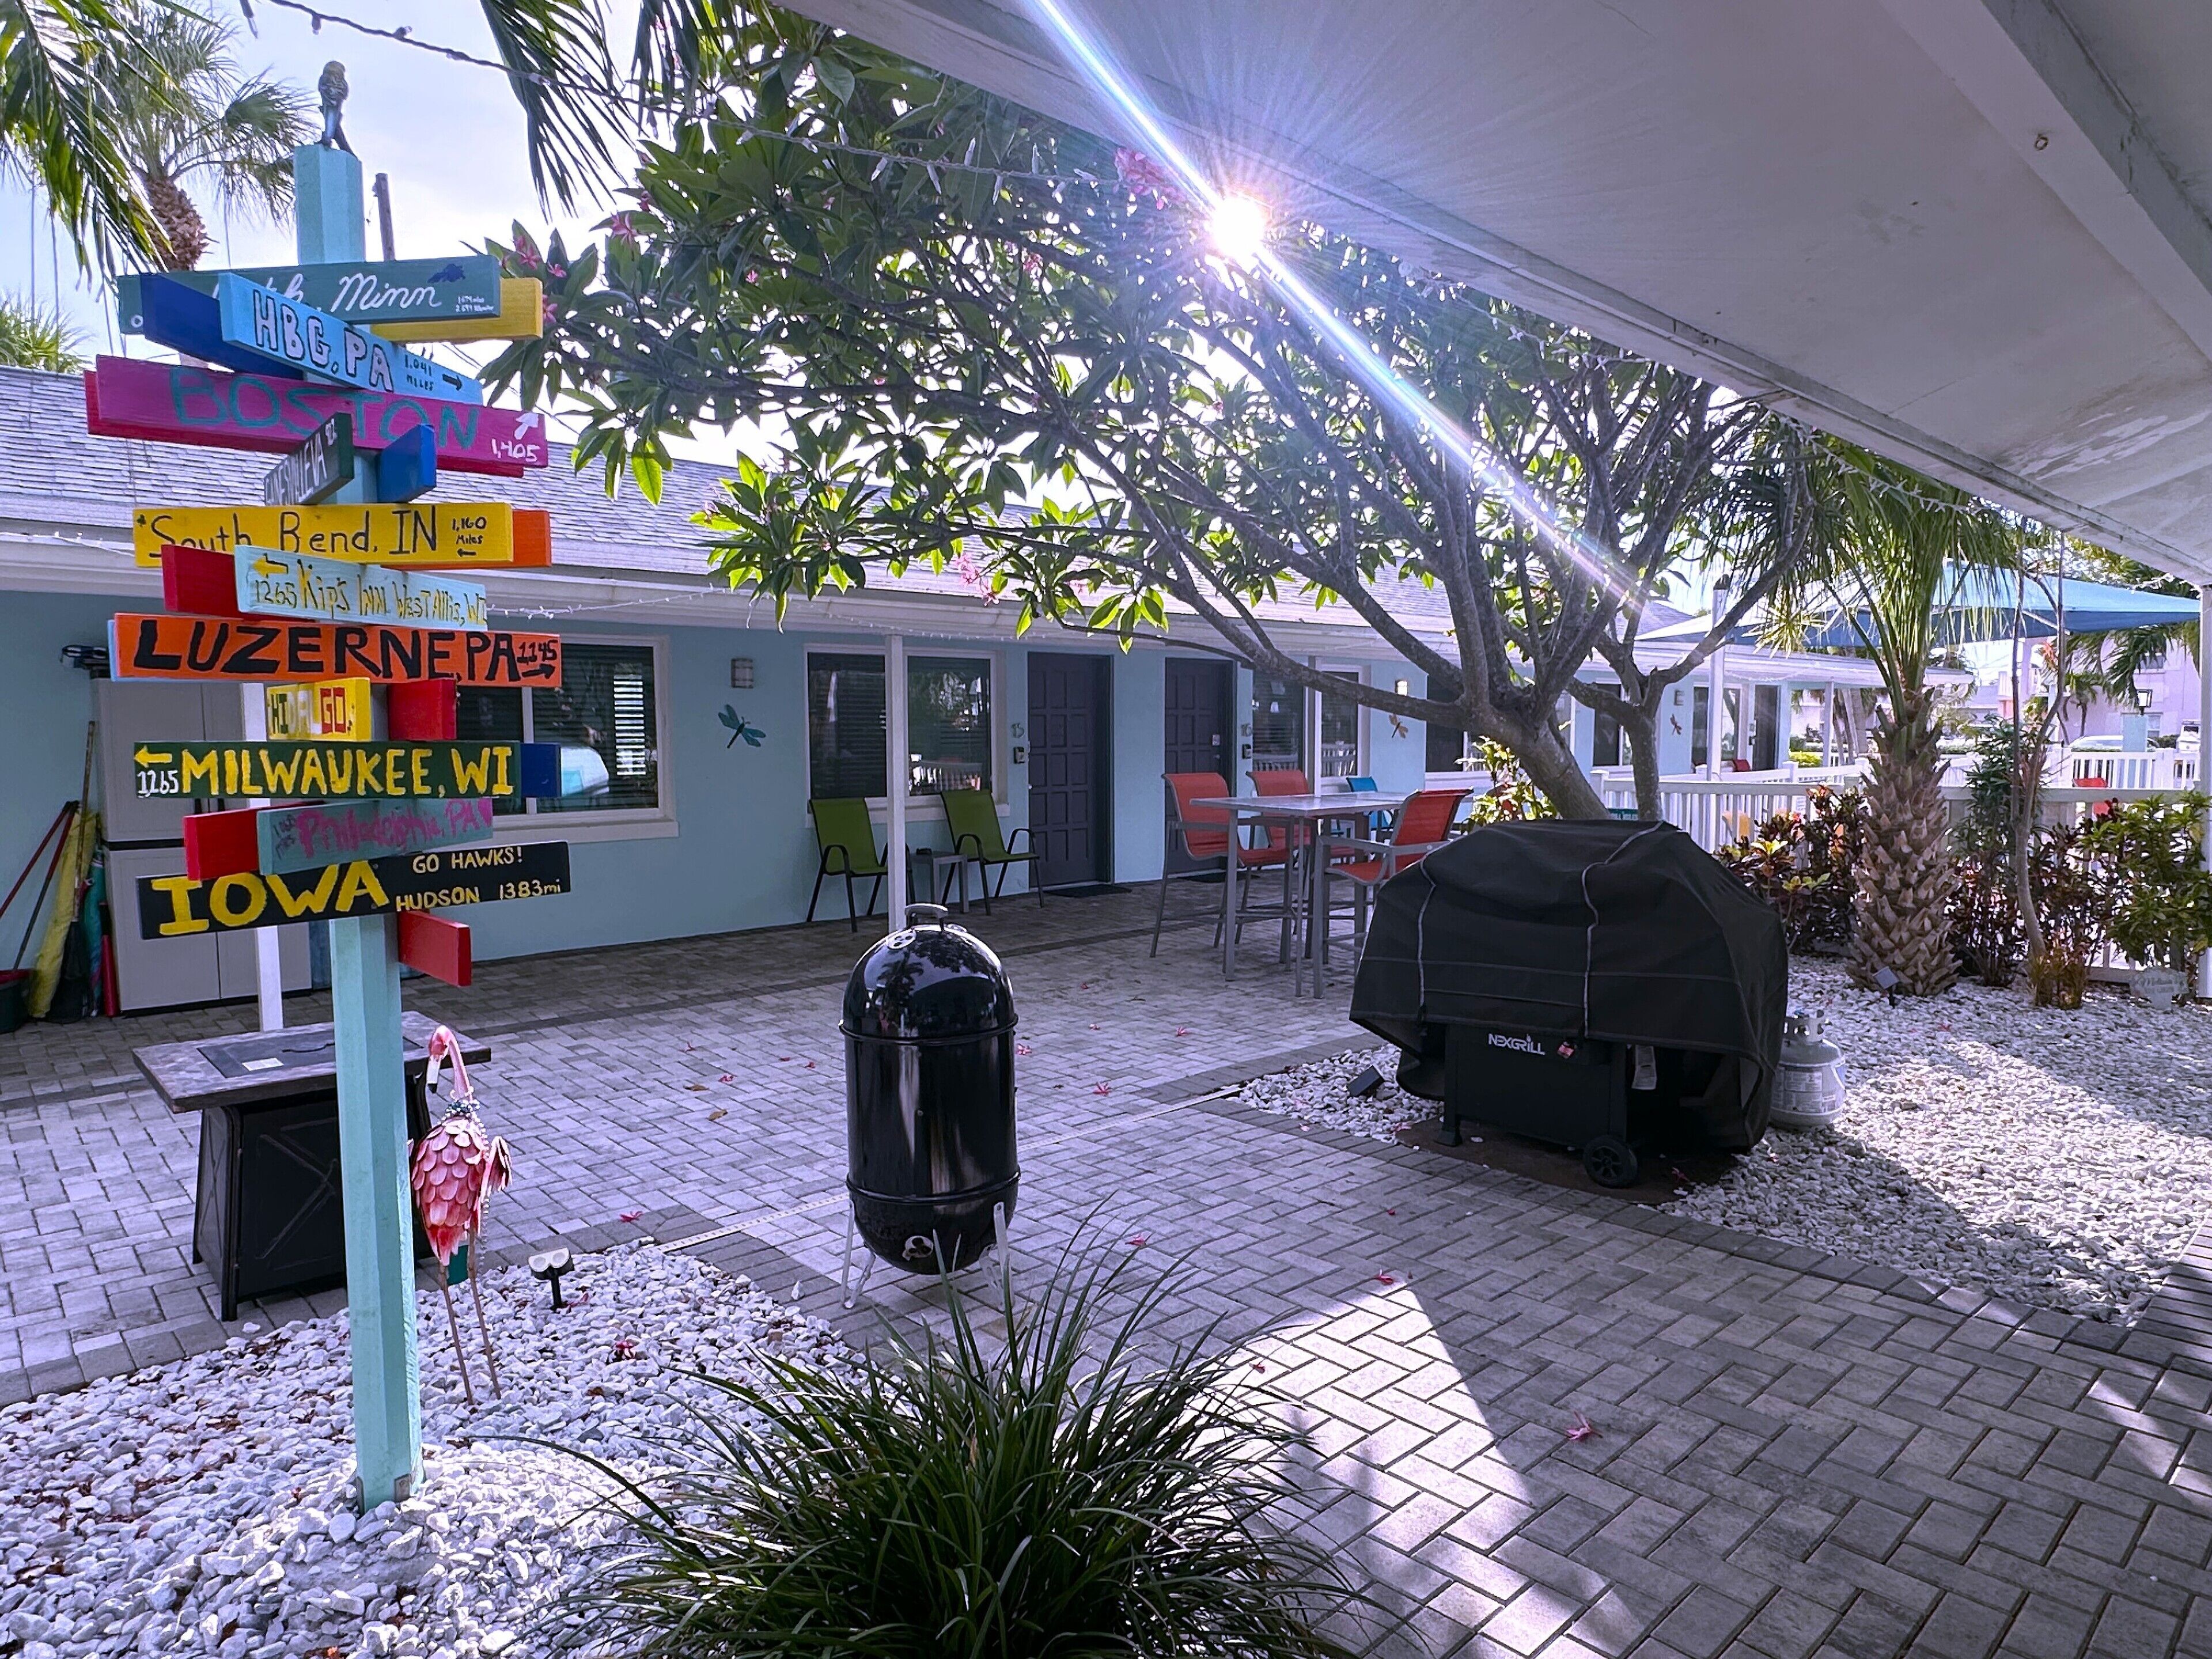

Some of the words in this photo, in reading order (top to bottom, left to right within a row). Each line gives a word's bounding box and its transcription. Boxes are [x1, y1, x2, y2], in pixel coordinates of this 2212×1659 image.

[330, 273, 442, 312] Minn
[406, 374, 434, 392] MILES
[168, 365, 480, 450] BOSTON
[491, 438, 540, 463] 1,405
[389, 505, 437, 555] IN
[452, 517, 487, 532] 1,160
[456, 534, 483, 544] Miles
[255, 578, 297, 609] 1265
[181, 747, 447, 798] MILWAUKEE,
[450, 746, 514, 795] WI
[445, 798, 480, 838] PA
[412, 853, 440, 874] GO
[450, 846, 522, 869] HAWKS!
[150, 859, 390, 936] IOWA
[396, 886, 480, 912] HUDSON
